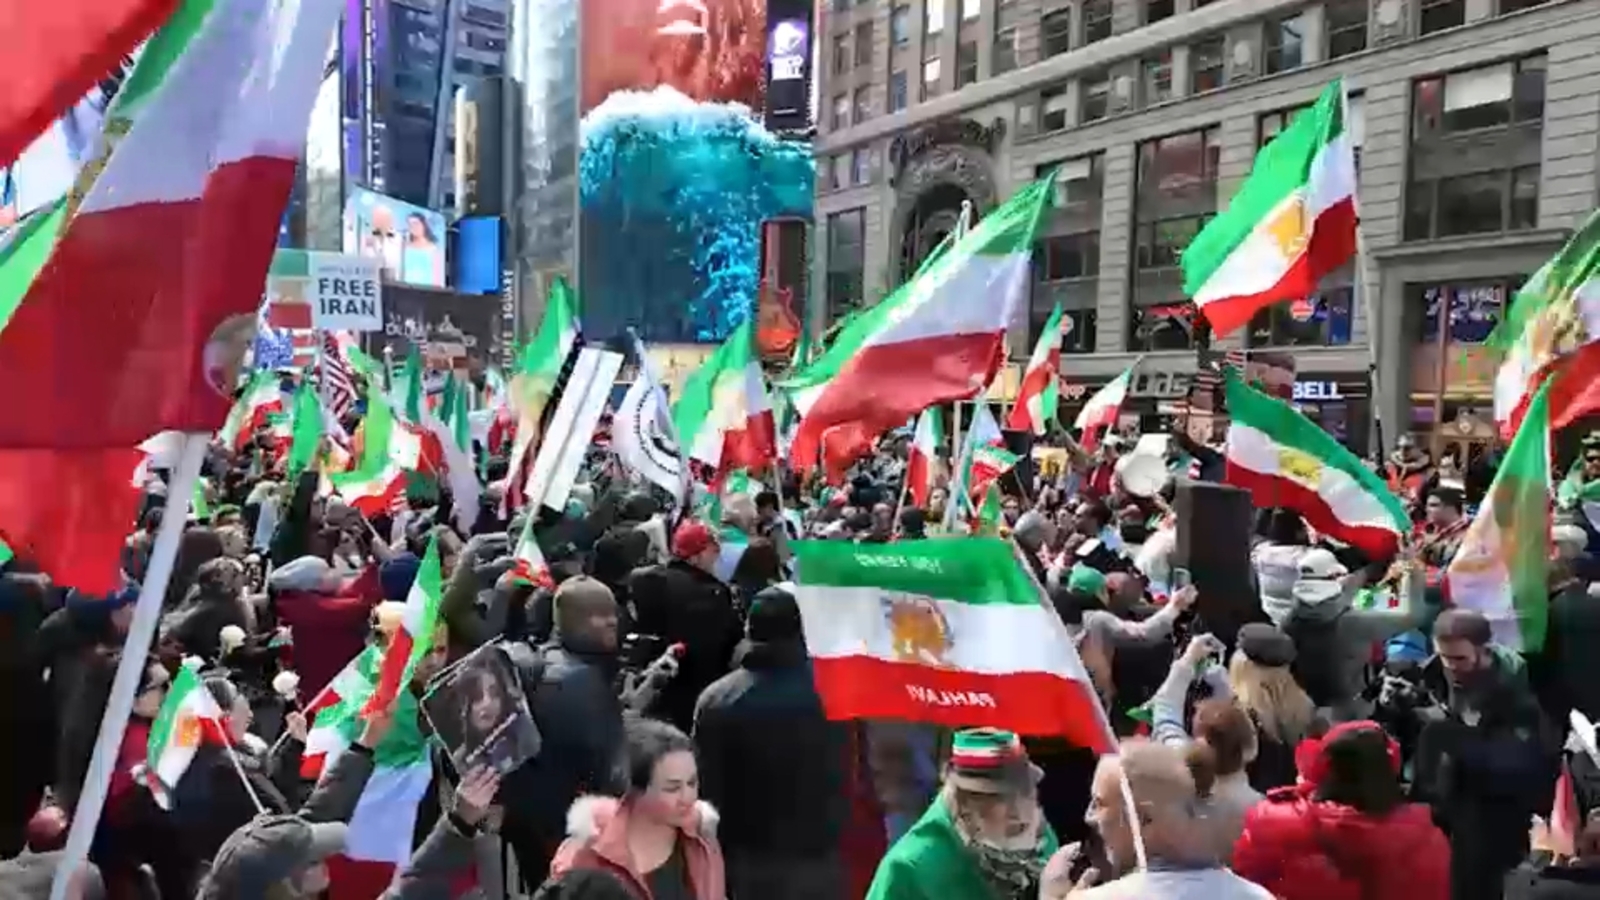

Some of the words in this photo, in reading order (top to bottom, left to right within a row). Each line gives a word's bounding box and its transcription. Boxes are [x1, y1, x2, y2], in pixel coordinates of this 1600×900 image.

[318, 277, 376, 297] FREE
[503, 269, 514, 319] SQUARE
[320, 298, 377, 318] IRAN
[1129, 371, 1189, 398] Lids
[1293, 381, 1344, 399] BELL
